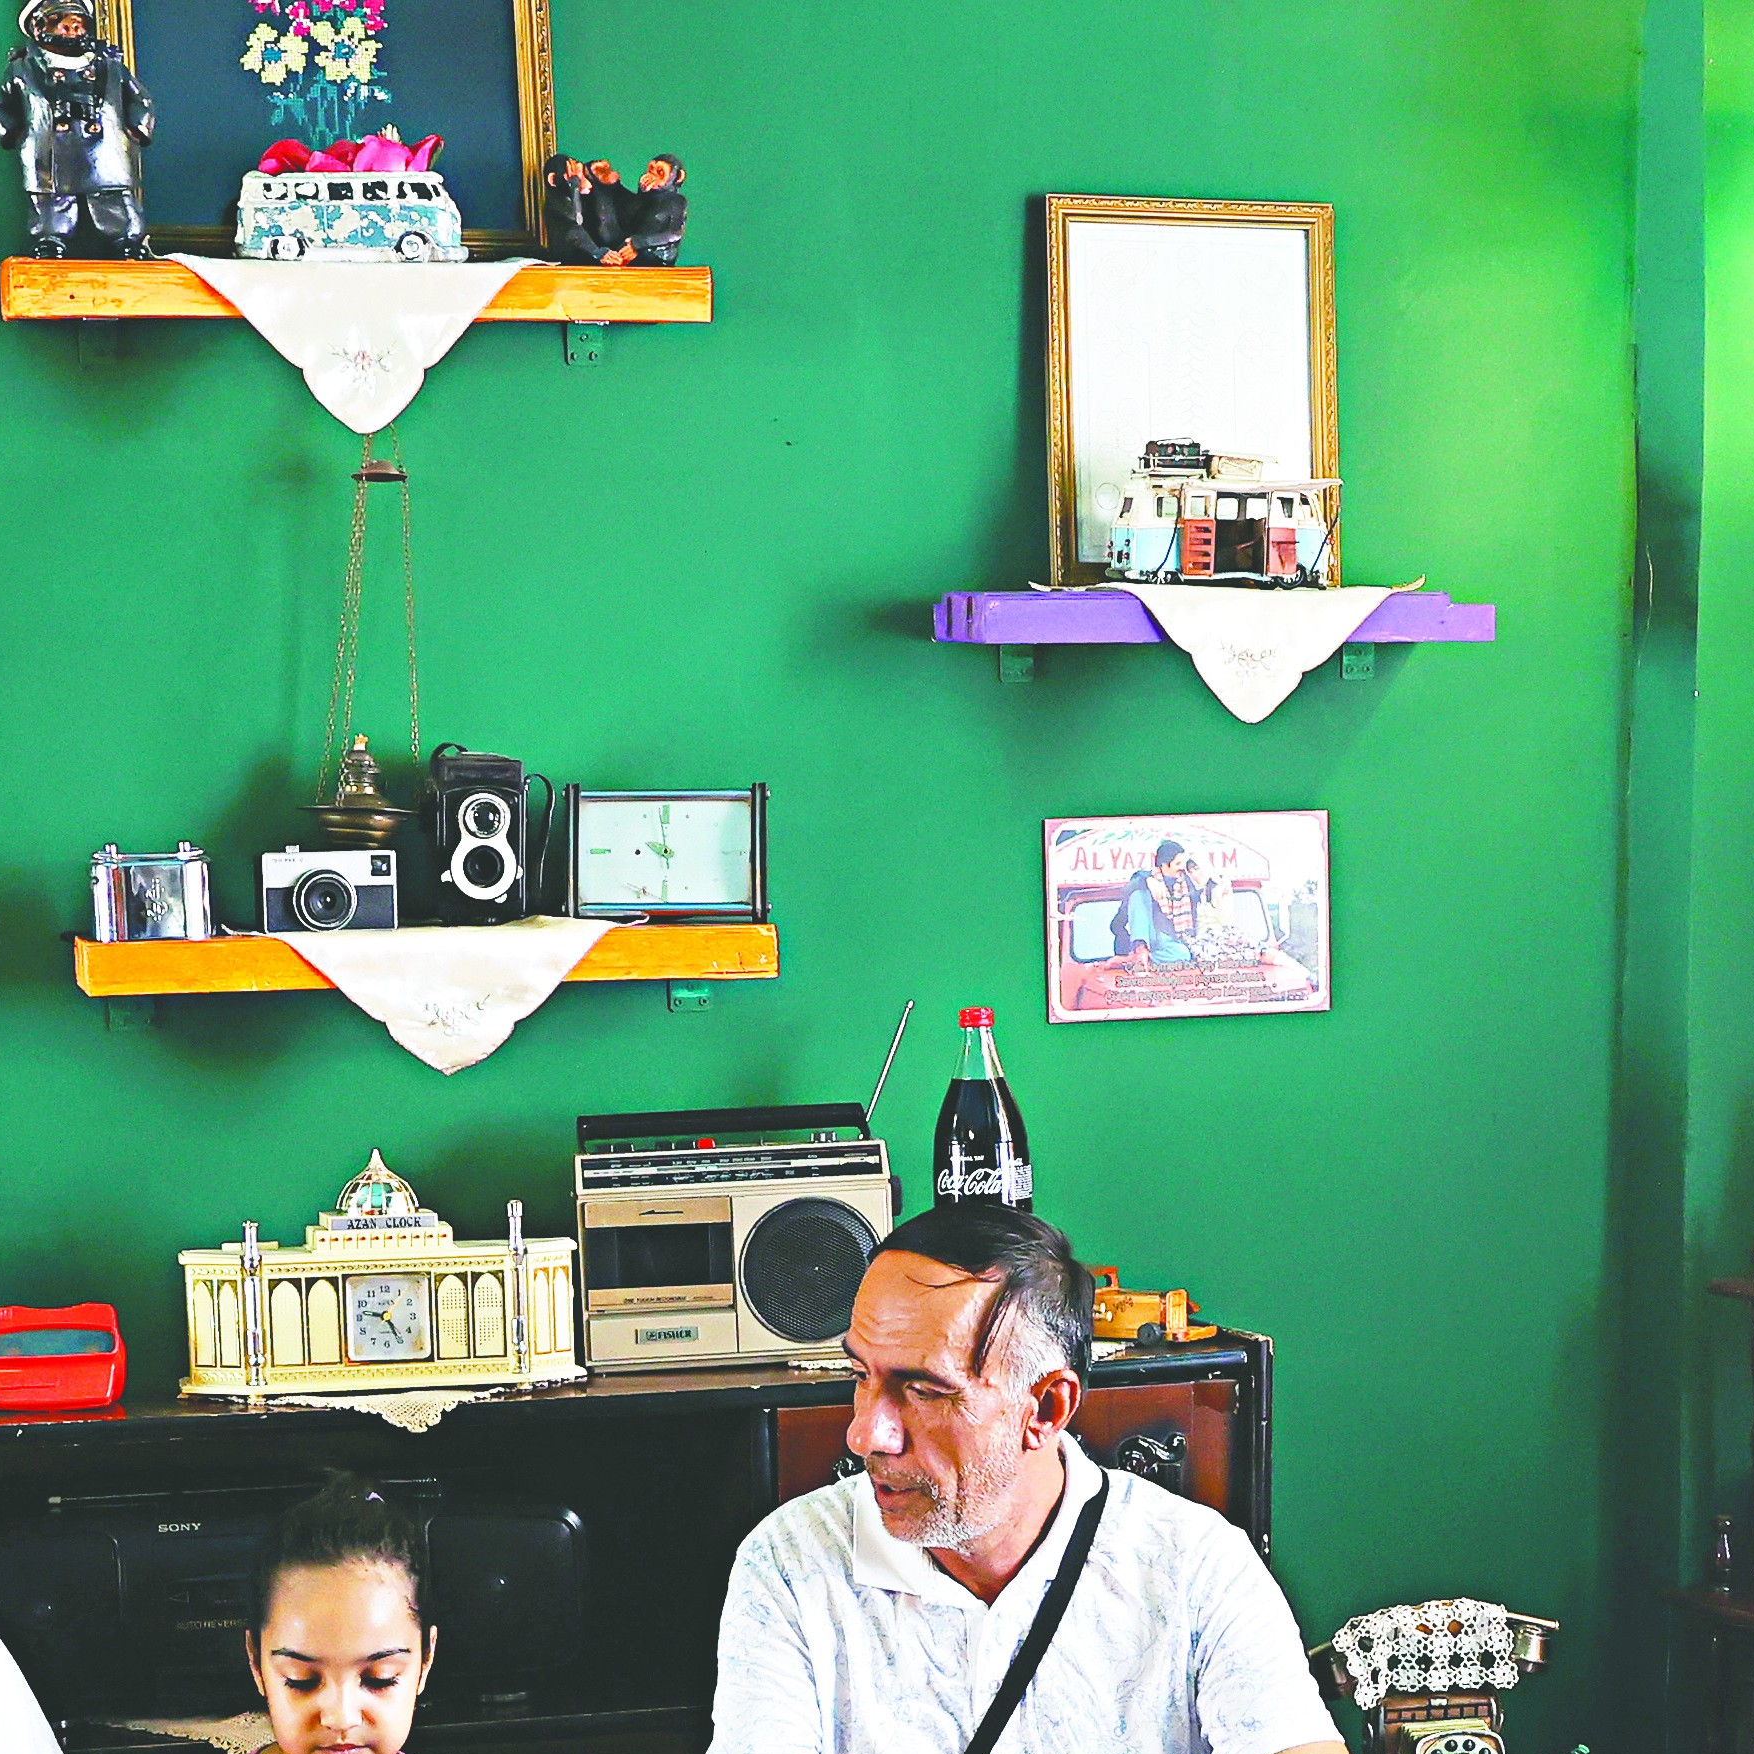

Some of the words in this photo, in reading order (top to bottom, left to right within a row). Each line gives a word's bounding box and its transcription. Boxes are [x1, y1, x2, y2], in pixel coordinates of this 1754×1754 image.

[1070, 846, 1105, 871] AL
[347, 1218, 377, 1230] AZAN
[385, 1216, 422, 1229] CLOCK
[367, 1290, 376, 1298] 11
[379, 1285, 391, 1294] 12
[397, 1289, 402, 1297] 1
[357, 1300, 368, 1309] 10
[406, 1298, 413, 1306] 2
[410, 1312, 417, 1321] 3
[406, 1326, 412, 1335] 4
[370, 1337, 377, 1346] 7
[384, 1340, 391, 1349] 6
[158, 1523, 202, 1533] SONY
